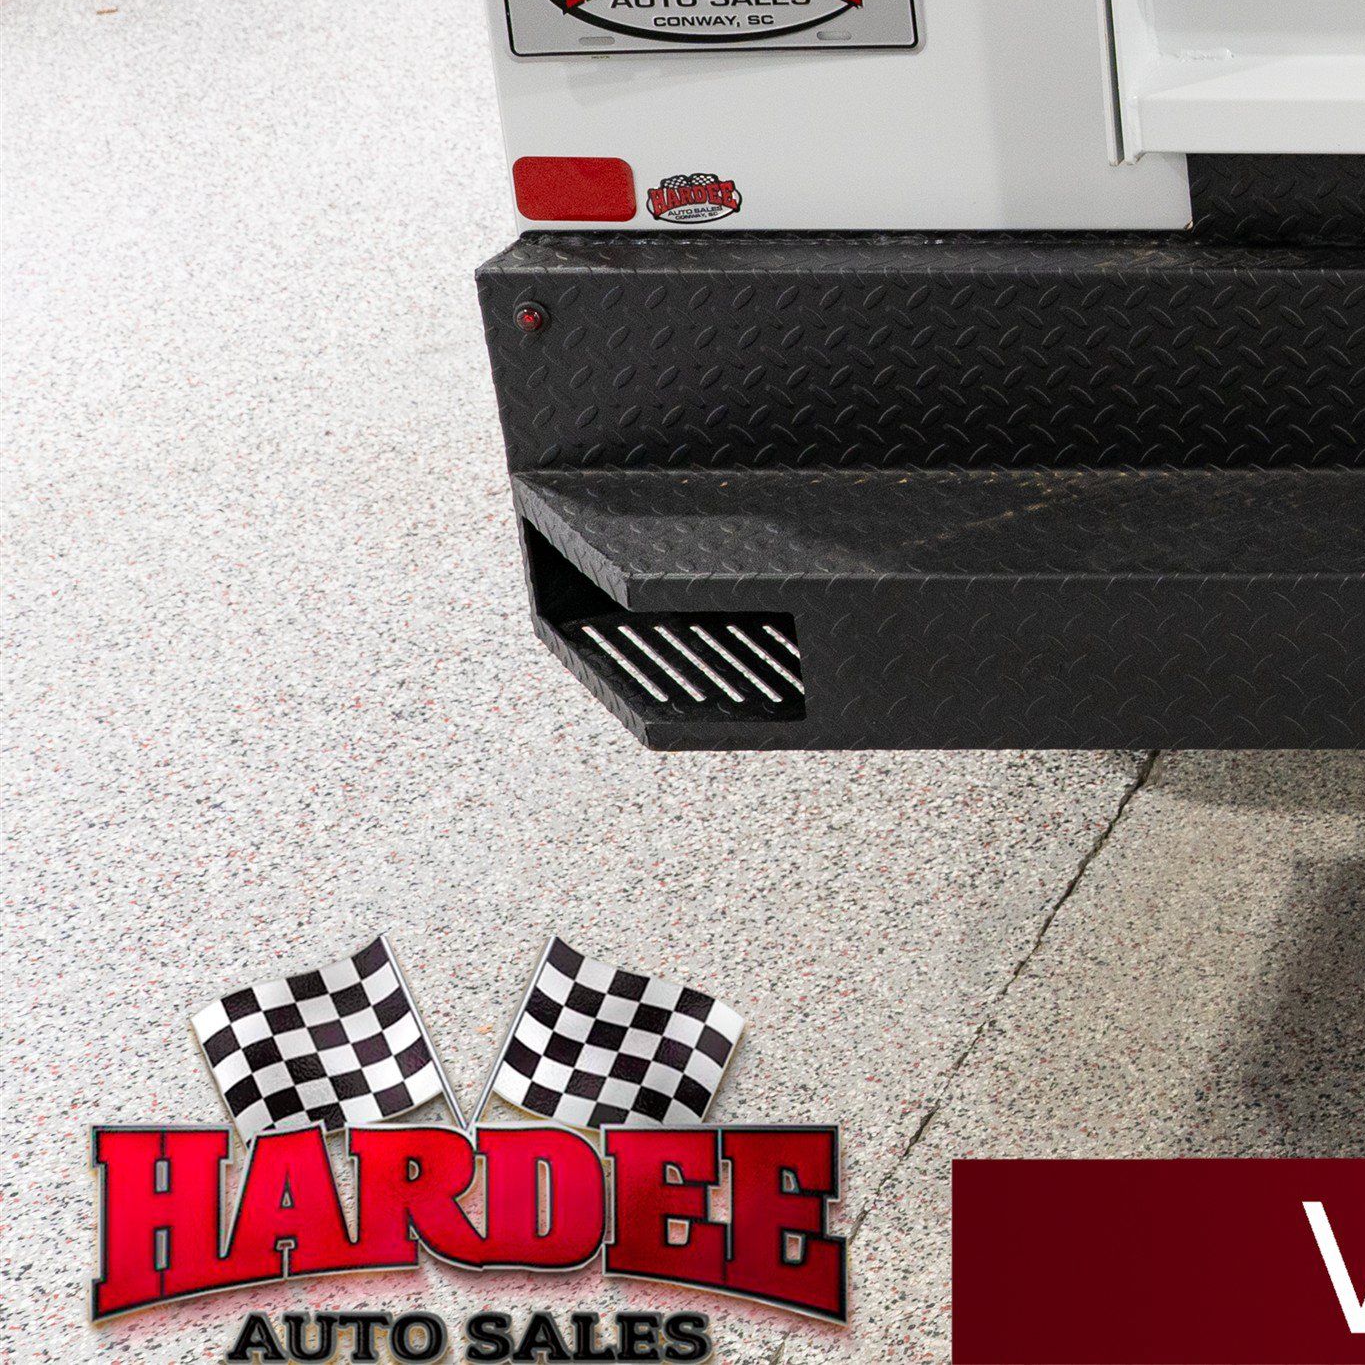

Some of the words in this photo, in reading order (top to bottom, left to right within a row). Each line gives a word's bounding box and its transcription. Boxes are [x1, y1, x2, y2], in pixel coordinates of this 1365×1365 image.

[653, 15, 741, 29] CONWAY,
[747, 14, 775, 26] SC
[649, 181, 738, 218] HARDEE
[668, 208, 693, 217] AUTO
[693, 206, 723, 214] SALES
